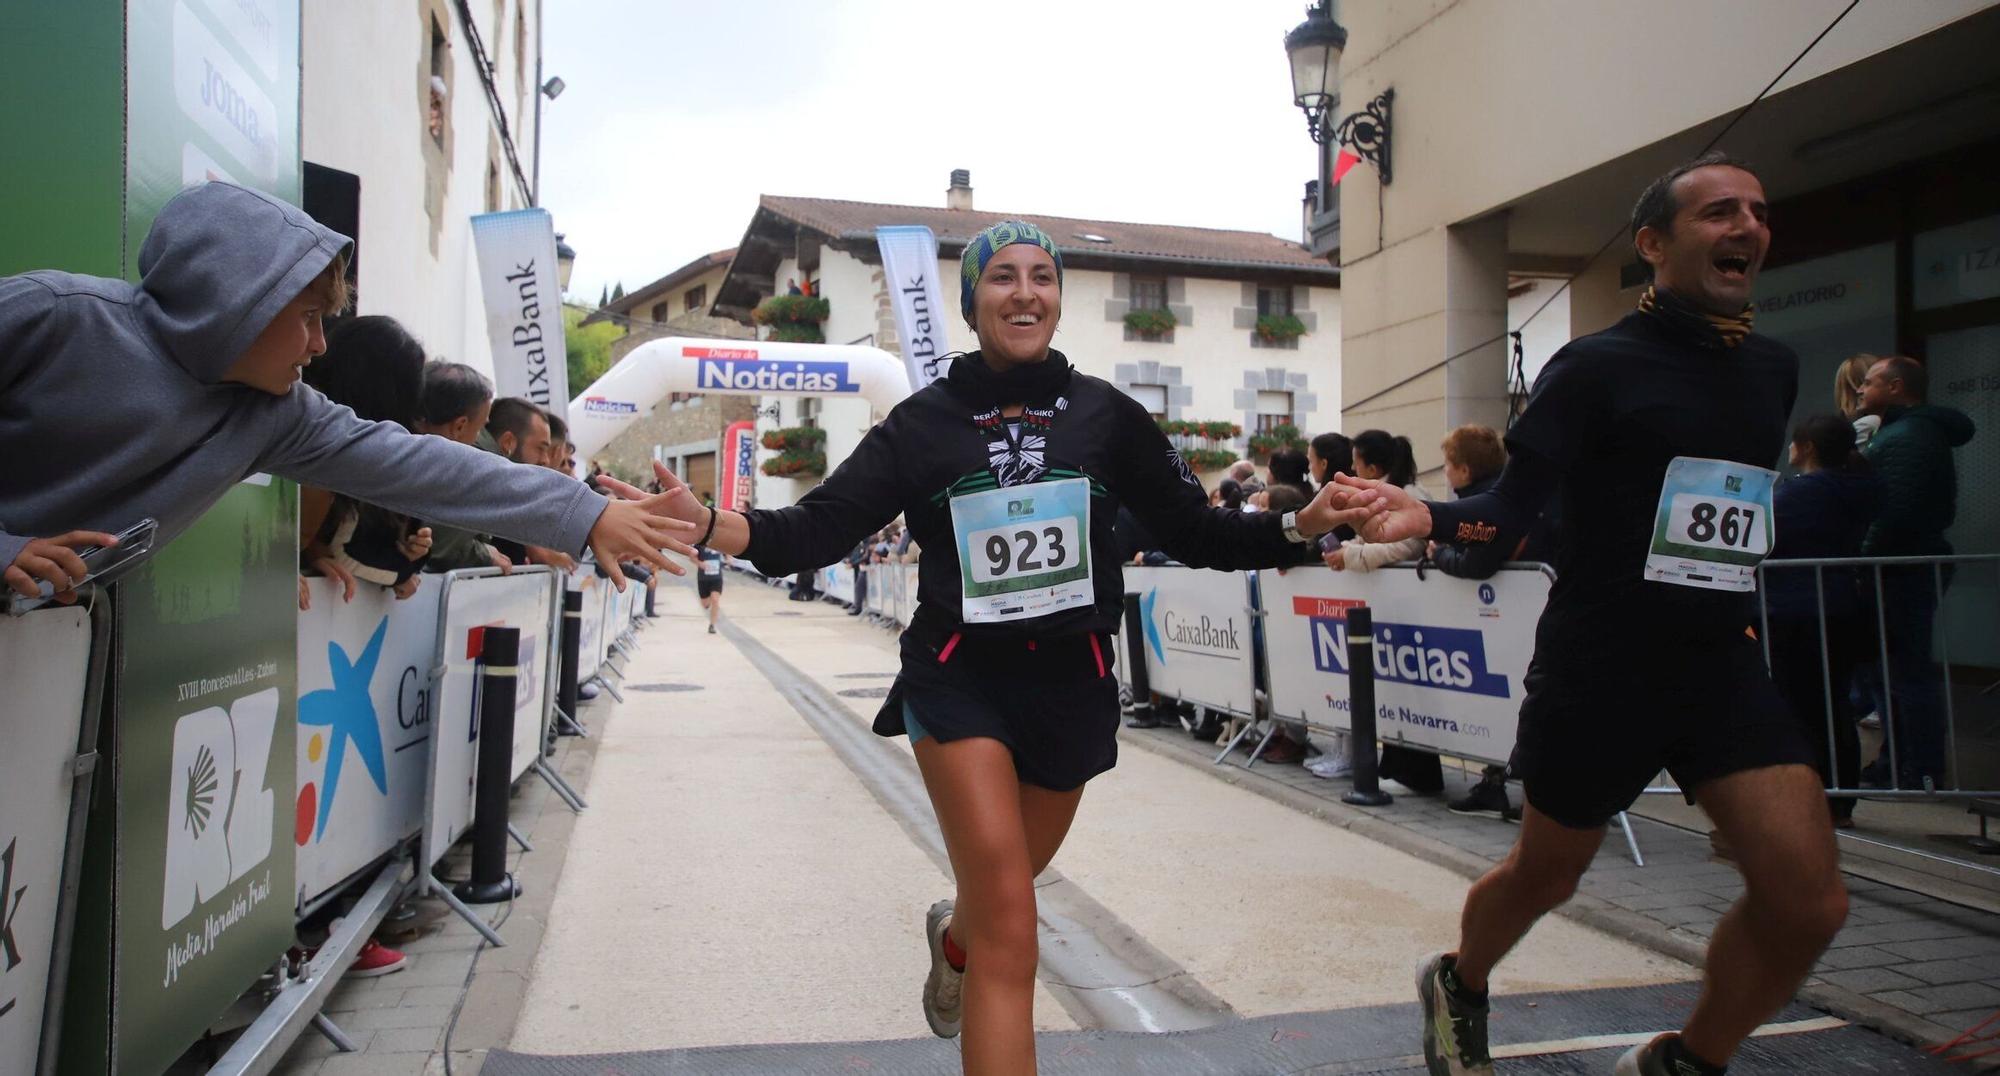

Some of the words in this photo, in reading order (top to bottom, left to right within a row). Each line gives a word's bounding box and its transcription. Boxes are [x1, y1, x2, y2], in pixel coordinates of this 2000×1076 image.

[201, 56, 262, 146] Joma
[1758, 283, 1846, 313] VELATORIO
[506, 256, 550, 406] ixaBank
[903, 273, 939, 380] aBank
[704, 361, 838, 391] Noticias
[708, 349, 742, 359] Diario
[743, 349, 757, 360] de
[736, 434, 753, 513] TERSPORT
[1687, 502, 1755, 548] 867
[985, 526, 1066, 576] 923
[1165, 610, 1239, 650] CaixaBank
[1316, 622, 1473, 688] Nticias
[178, 680, 199, 702] XVIII
[397, 665, 432, 730] Cai
[1379, 704, 1395, 720] de
[164, 932, 202, 988] Media
[248, 870, 271, 912] Trail
